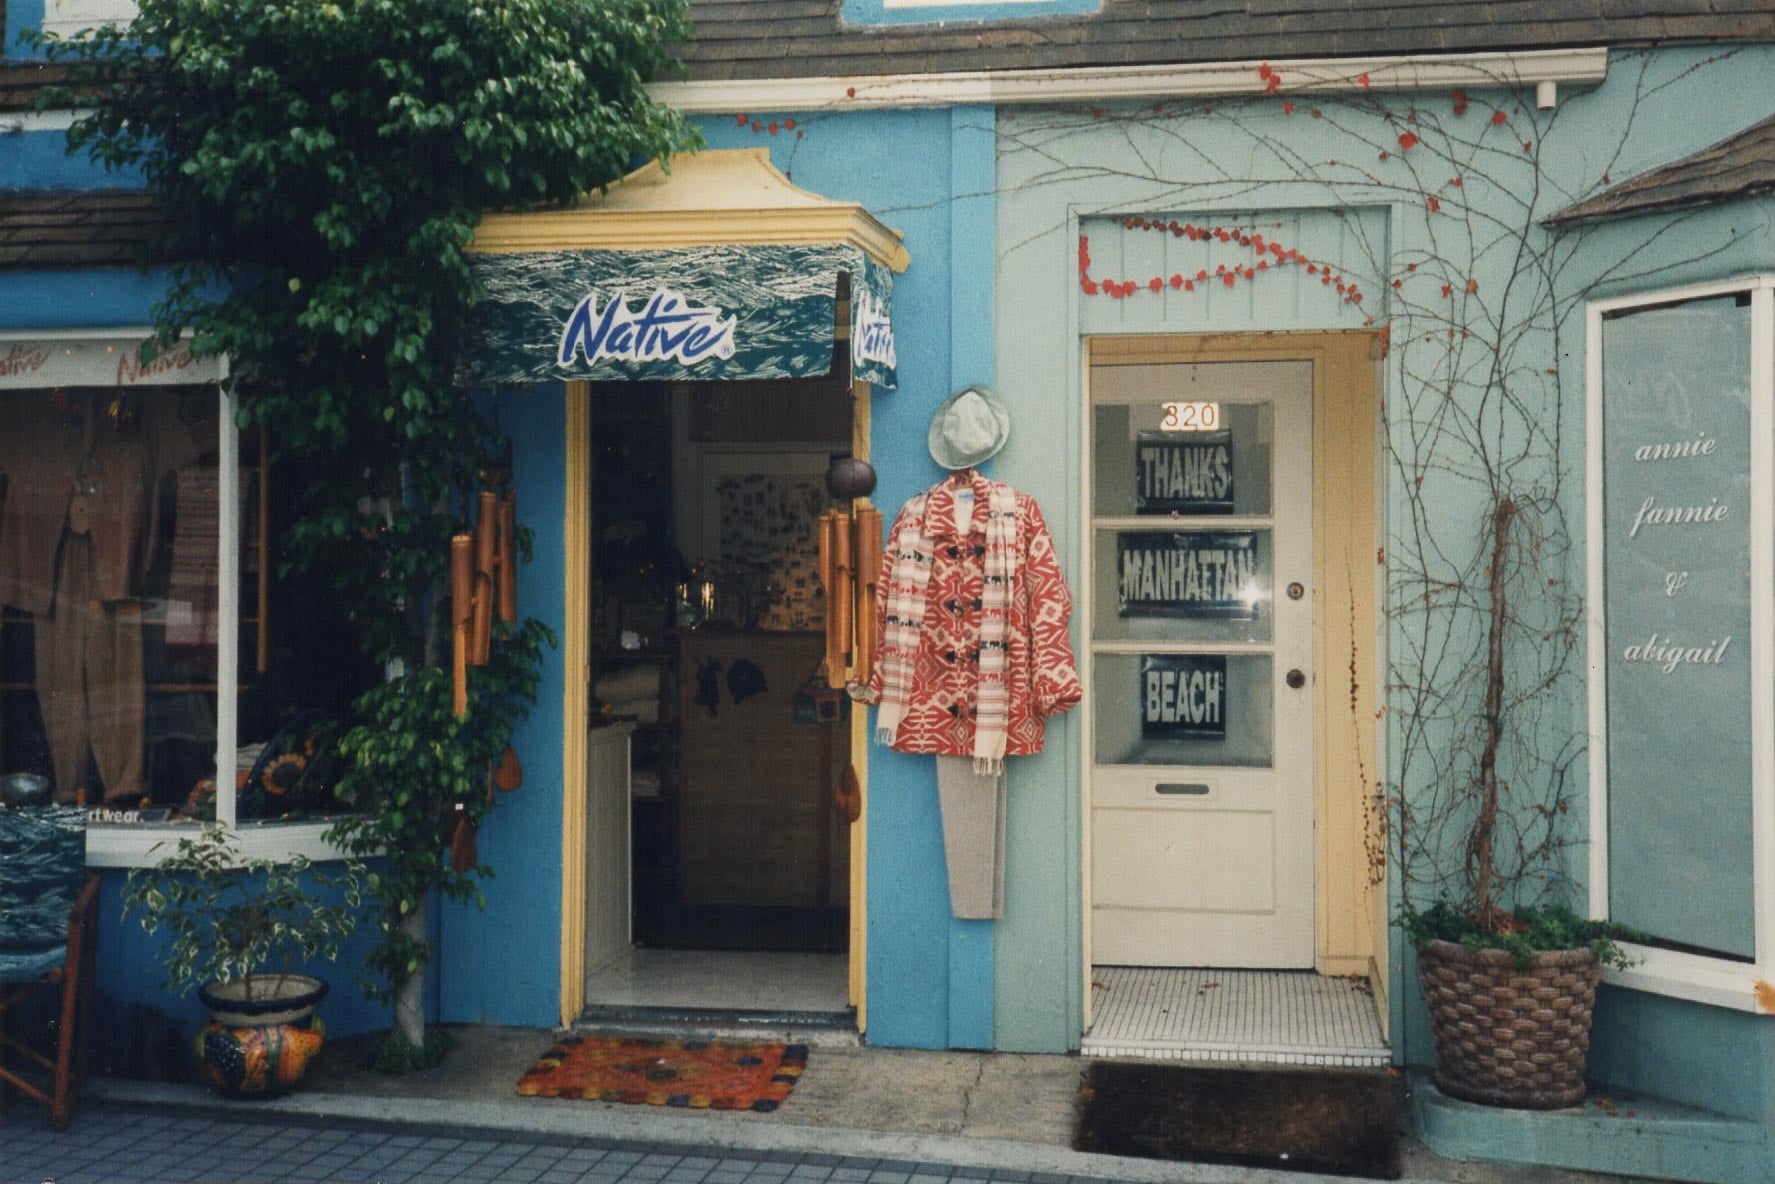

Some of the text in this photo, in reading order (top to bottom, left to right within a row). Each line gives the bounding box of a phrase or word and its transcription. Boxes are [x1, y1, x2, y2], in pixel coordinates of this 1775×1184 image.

[1165, 405, 1215, 427] 320
[1635, 432, 1716, 461] annie
[1141, 446, 1228, 499] THANKS
[1629, 497, 1728, 537] fannie
[1122, 550, 1256, 600] MANHATTAN
[1666, 571, 1688, 597] &
[1624, 634, 1731, 673] abigail
[1146, 670, 1220, 723] BEACH
